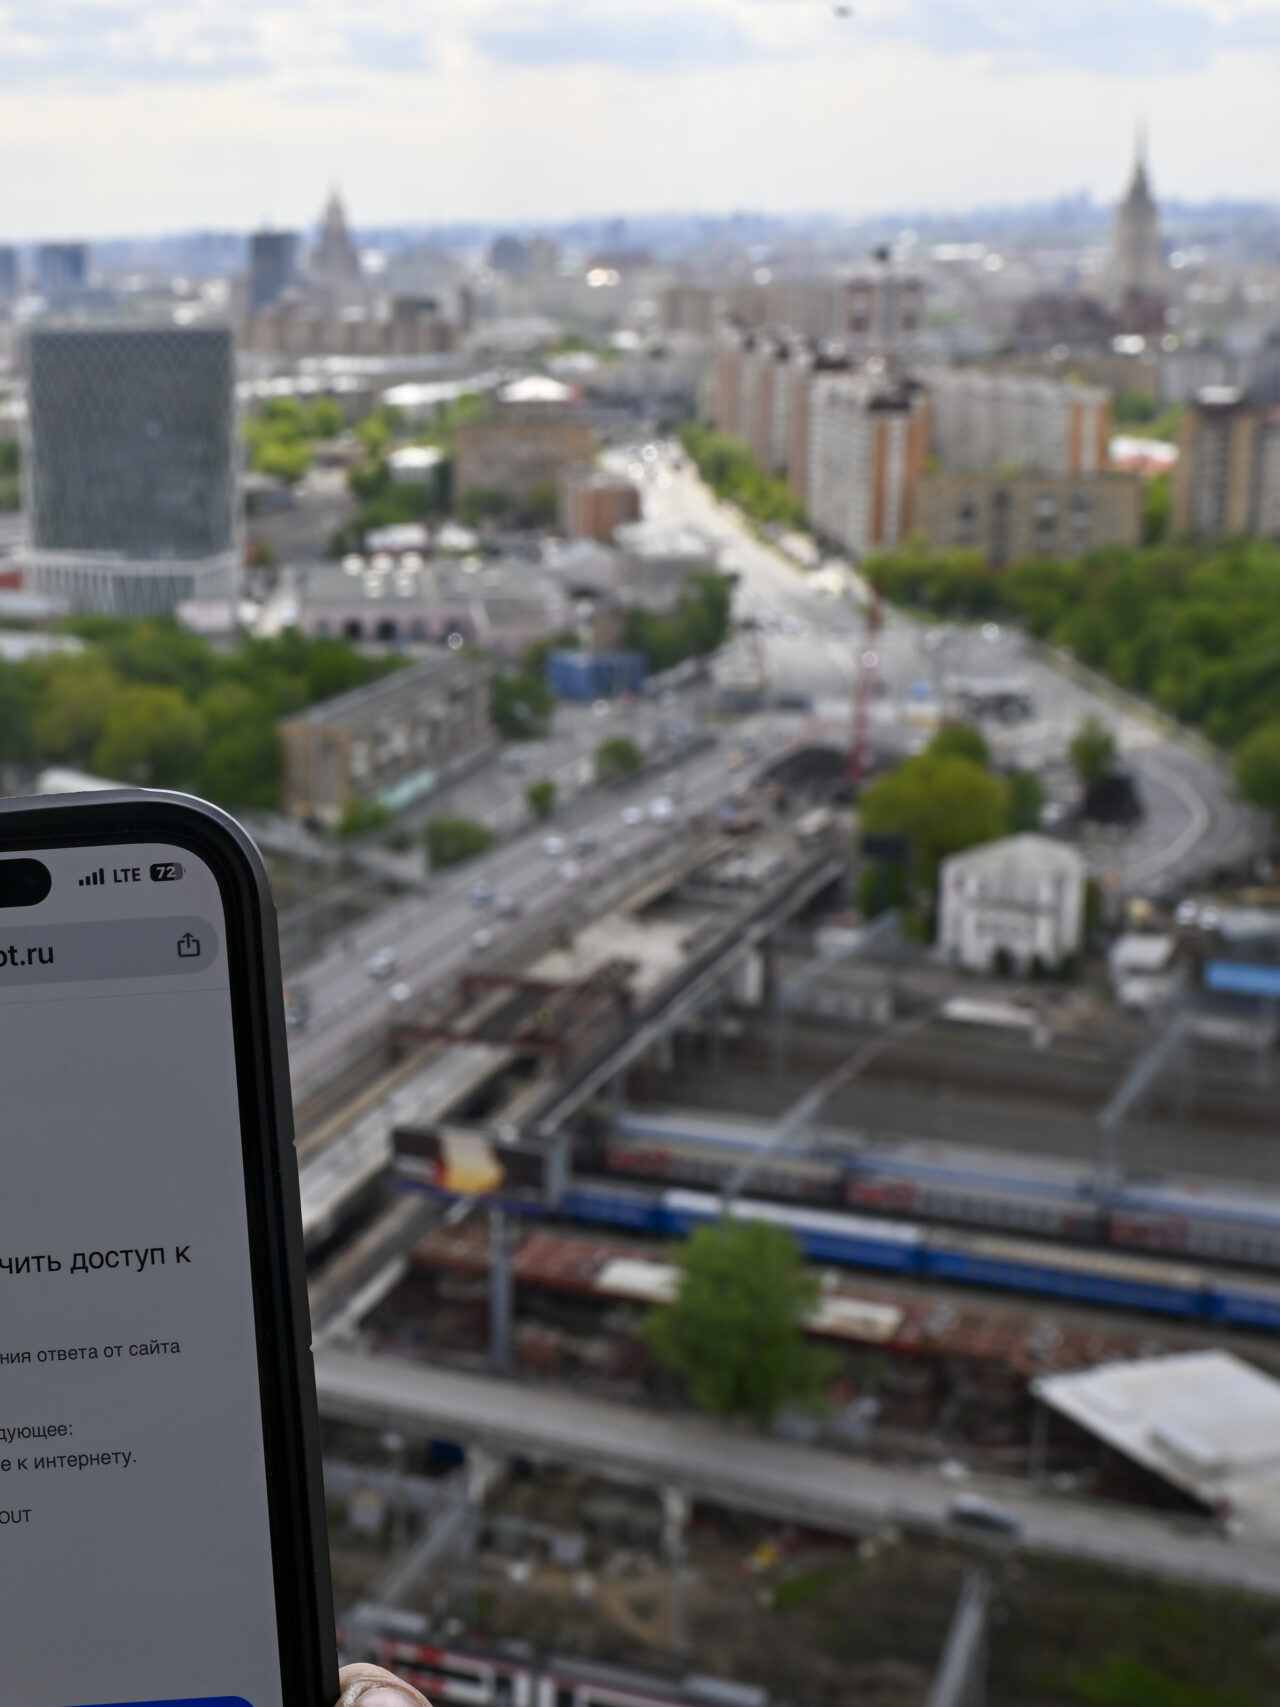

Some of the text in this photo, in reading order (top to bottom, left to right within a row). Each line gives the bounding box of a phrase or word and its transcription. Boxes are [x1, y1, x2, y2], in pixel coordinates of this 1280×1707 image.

[113, 865, 177, 884] LTE 72
[70, 1247, 166, 1275] доступ
[175, 1245, 192, 1264] к
[36, 1346, 99, 1363] ответа
[103, 1345, 124, 1359] от
[128, 1339, 181, 1357] сайта
[17, 1458, 29, 1471] к
[34, 1451, 137, 1471] интернету.
